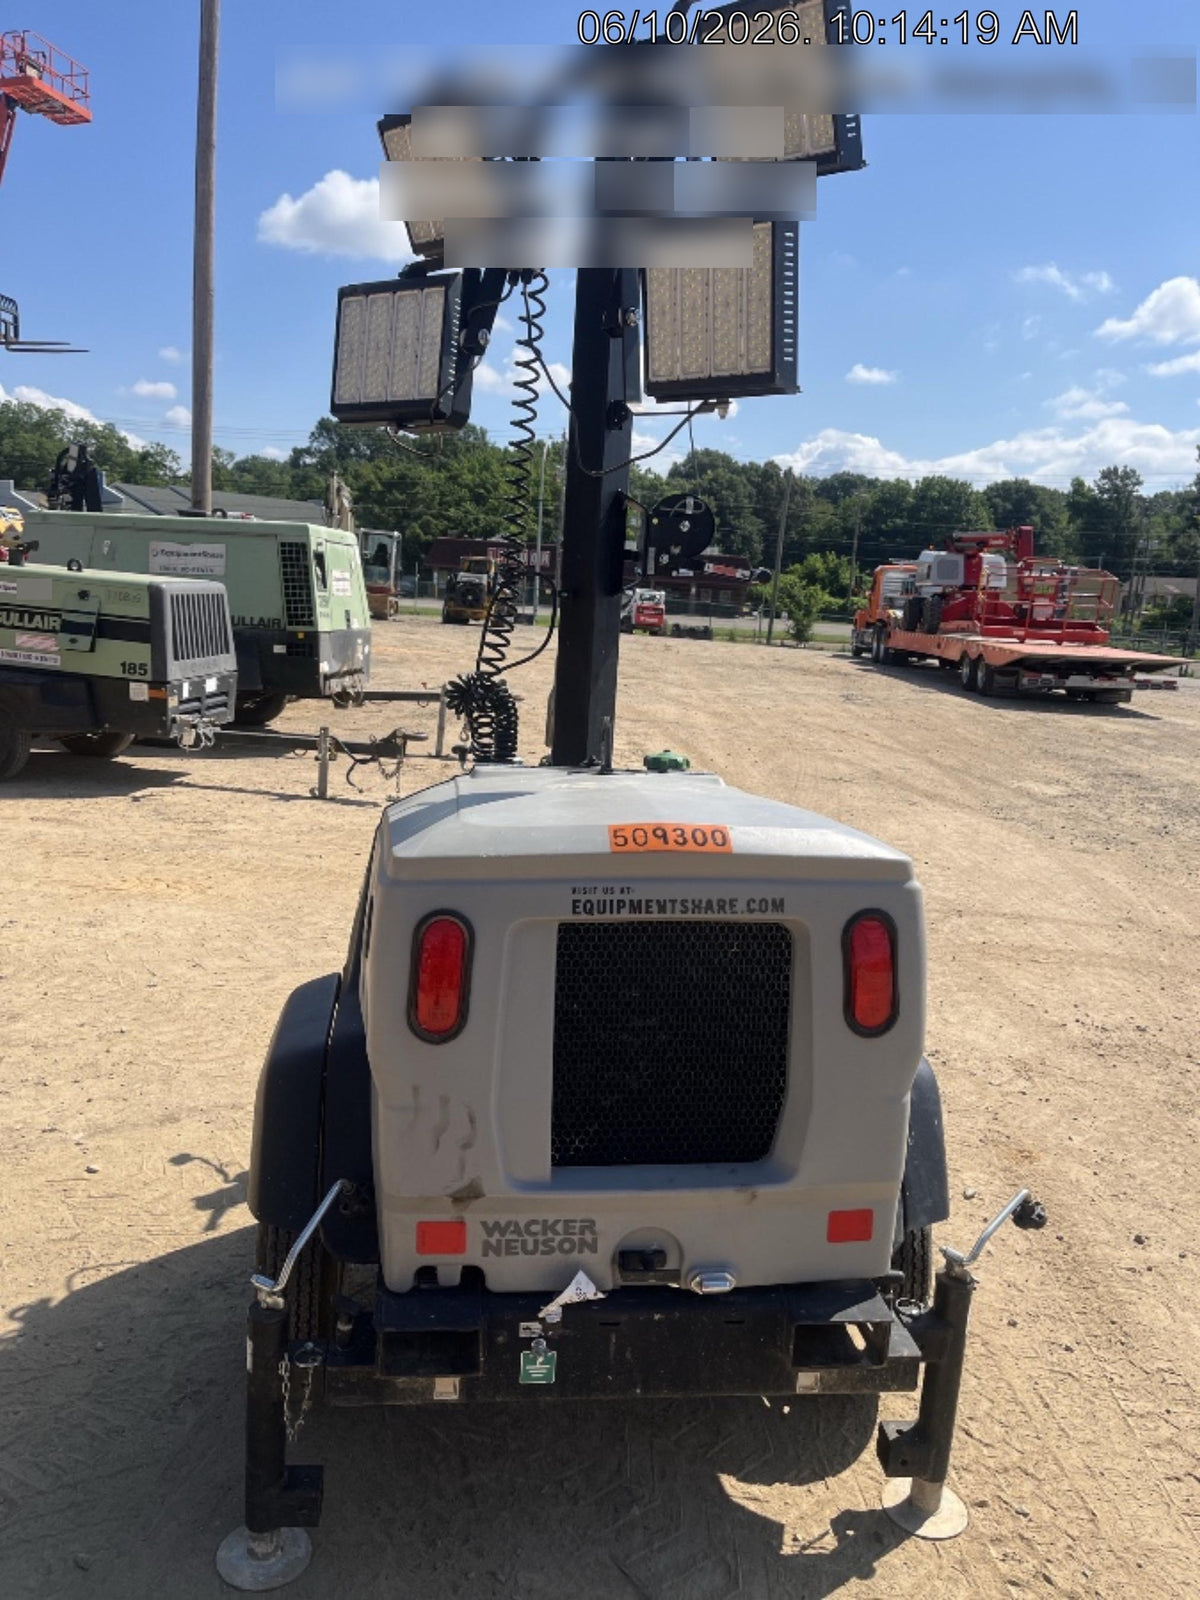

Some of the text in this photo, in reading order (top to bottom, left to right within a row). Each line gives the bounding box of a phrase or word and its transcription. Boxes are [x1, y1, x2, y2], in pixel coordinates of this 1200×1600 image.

[230, 615, 282, 629] ULLAIR
[120, 661, 148, 676] 185
[613, 827, 729, 847] 509300
[571, 886, 598, 895] VISIT
[602, 886, 615, 895] US
[571, 897, 785, 915] EQUIPMENTSHARE.COM
[480, 1218, 597, 1238] WACKER
[482, 1236, 598, 1258] NEUSON
